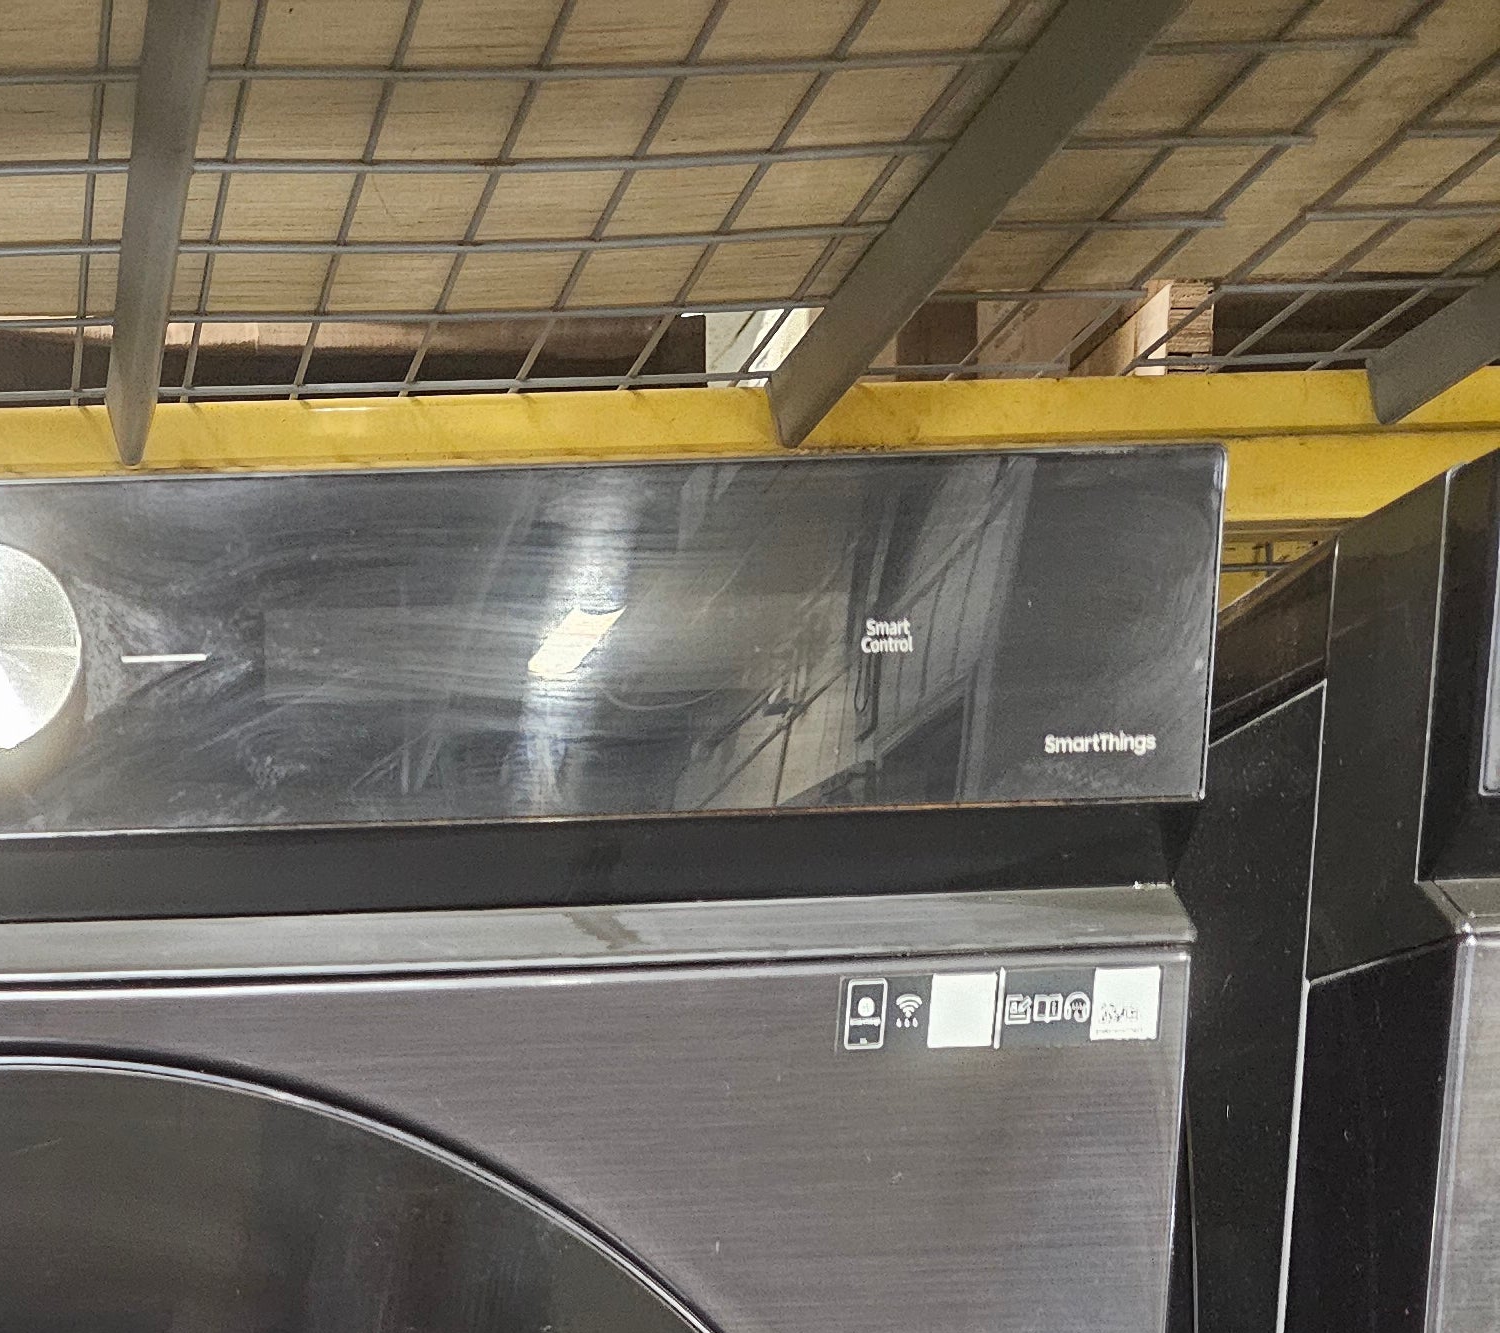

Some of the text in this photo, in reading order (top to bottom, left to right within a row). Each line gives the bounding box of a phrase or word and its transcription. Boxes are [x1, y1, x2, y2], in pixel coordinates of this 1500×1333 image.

[866, 618, 910, 636] Smart
[861, 636, 913, 653] Control
[1044, 730, 1157, 756] SmartThings
